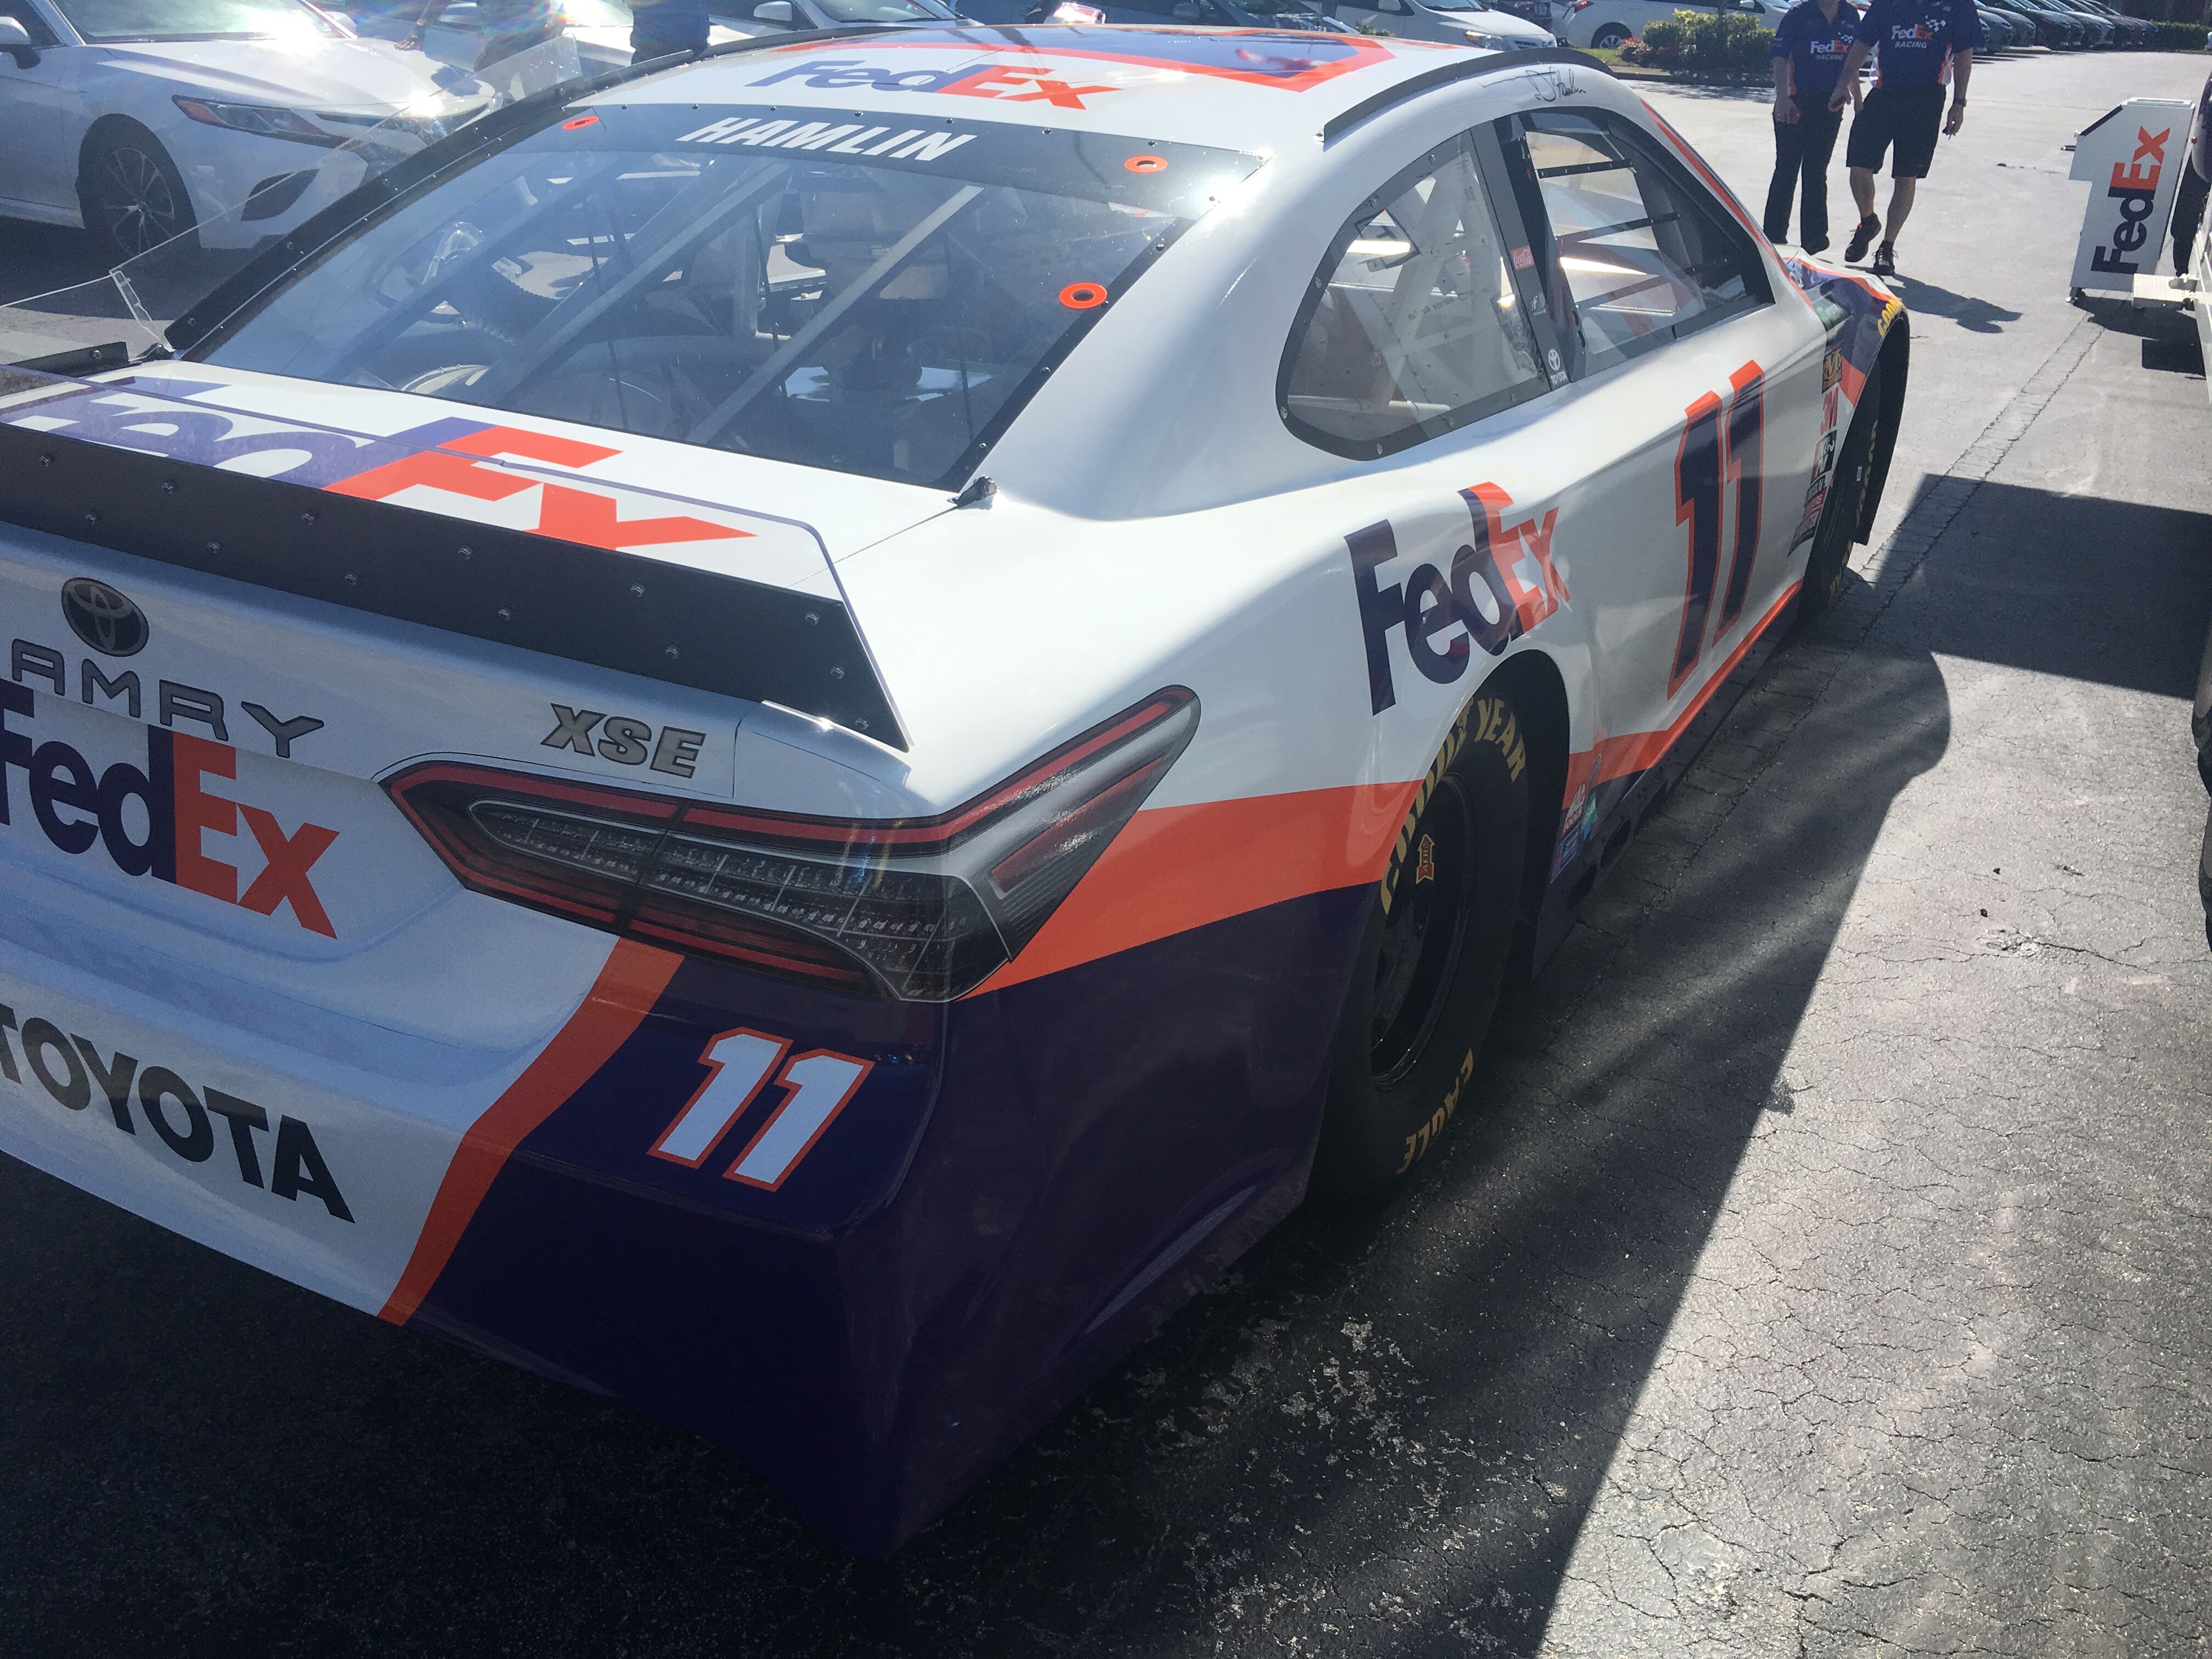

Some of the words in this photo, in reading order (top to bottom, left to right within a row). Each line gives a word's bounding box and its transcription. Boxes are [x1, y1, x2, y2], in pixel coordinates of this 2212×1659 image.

[744, 60, 1124, 110] FedEx
[1810, 40, 1848, 54] FedEx
[1891, 23, 1933, 41] FedEx
[676, 116, 978, 162] HAMLIN
[2091, 125, 2171, 275] FedEx
[1344, 481, 1572, 716] FedEx
[1667, 359, 1764, 701] 11
[0, 678, 340, 939] FedEx
[540, 703, 707, 778] XSE
[0, 1003, 356, 1224] TOYOTA
[646, 1026, 876, 1192] 11
